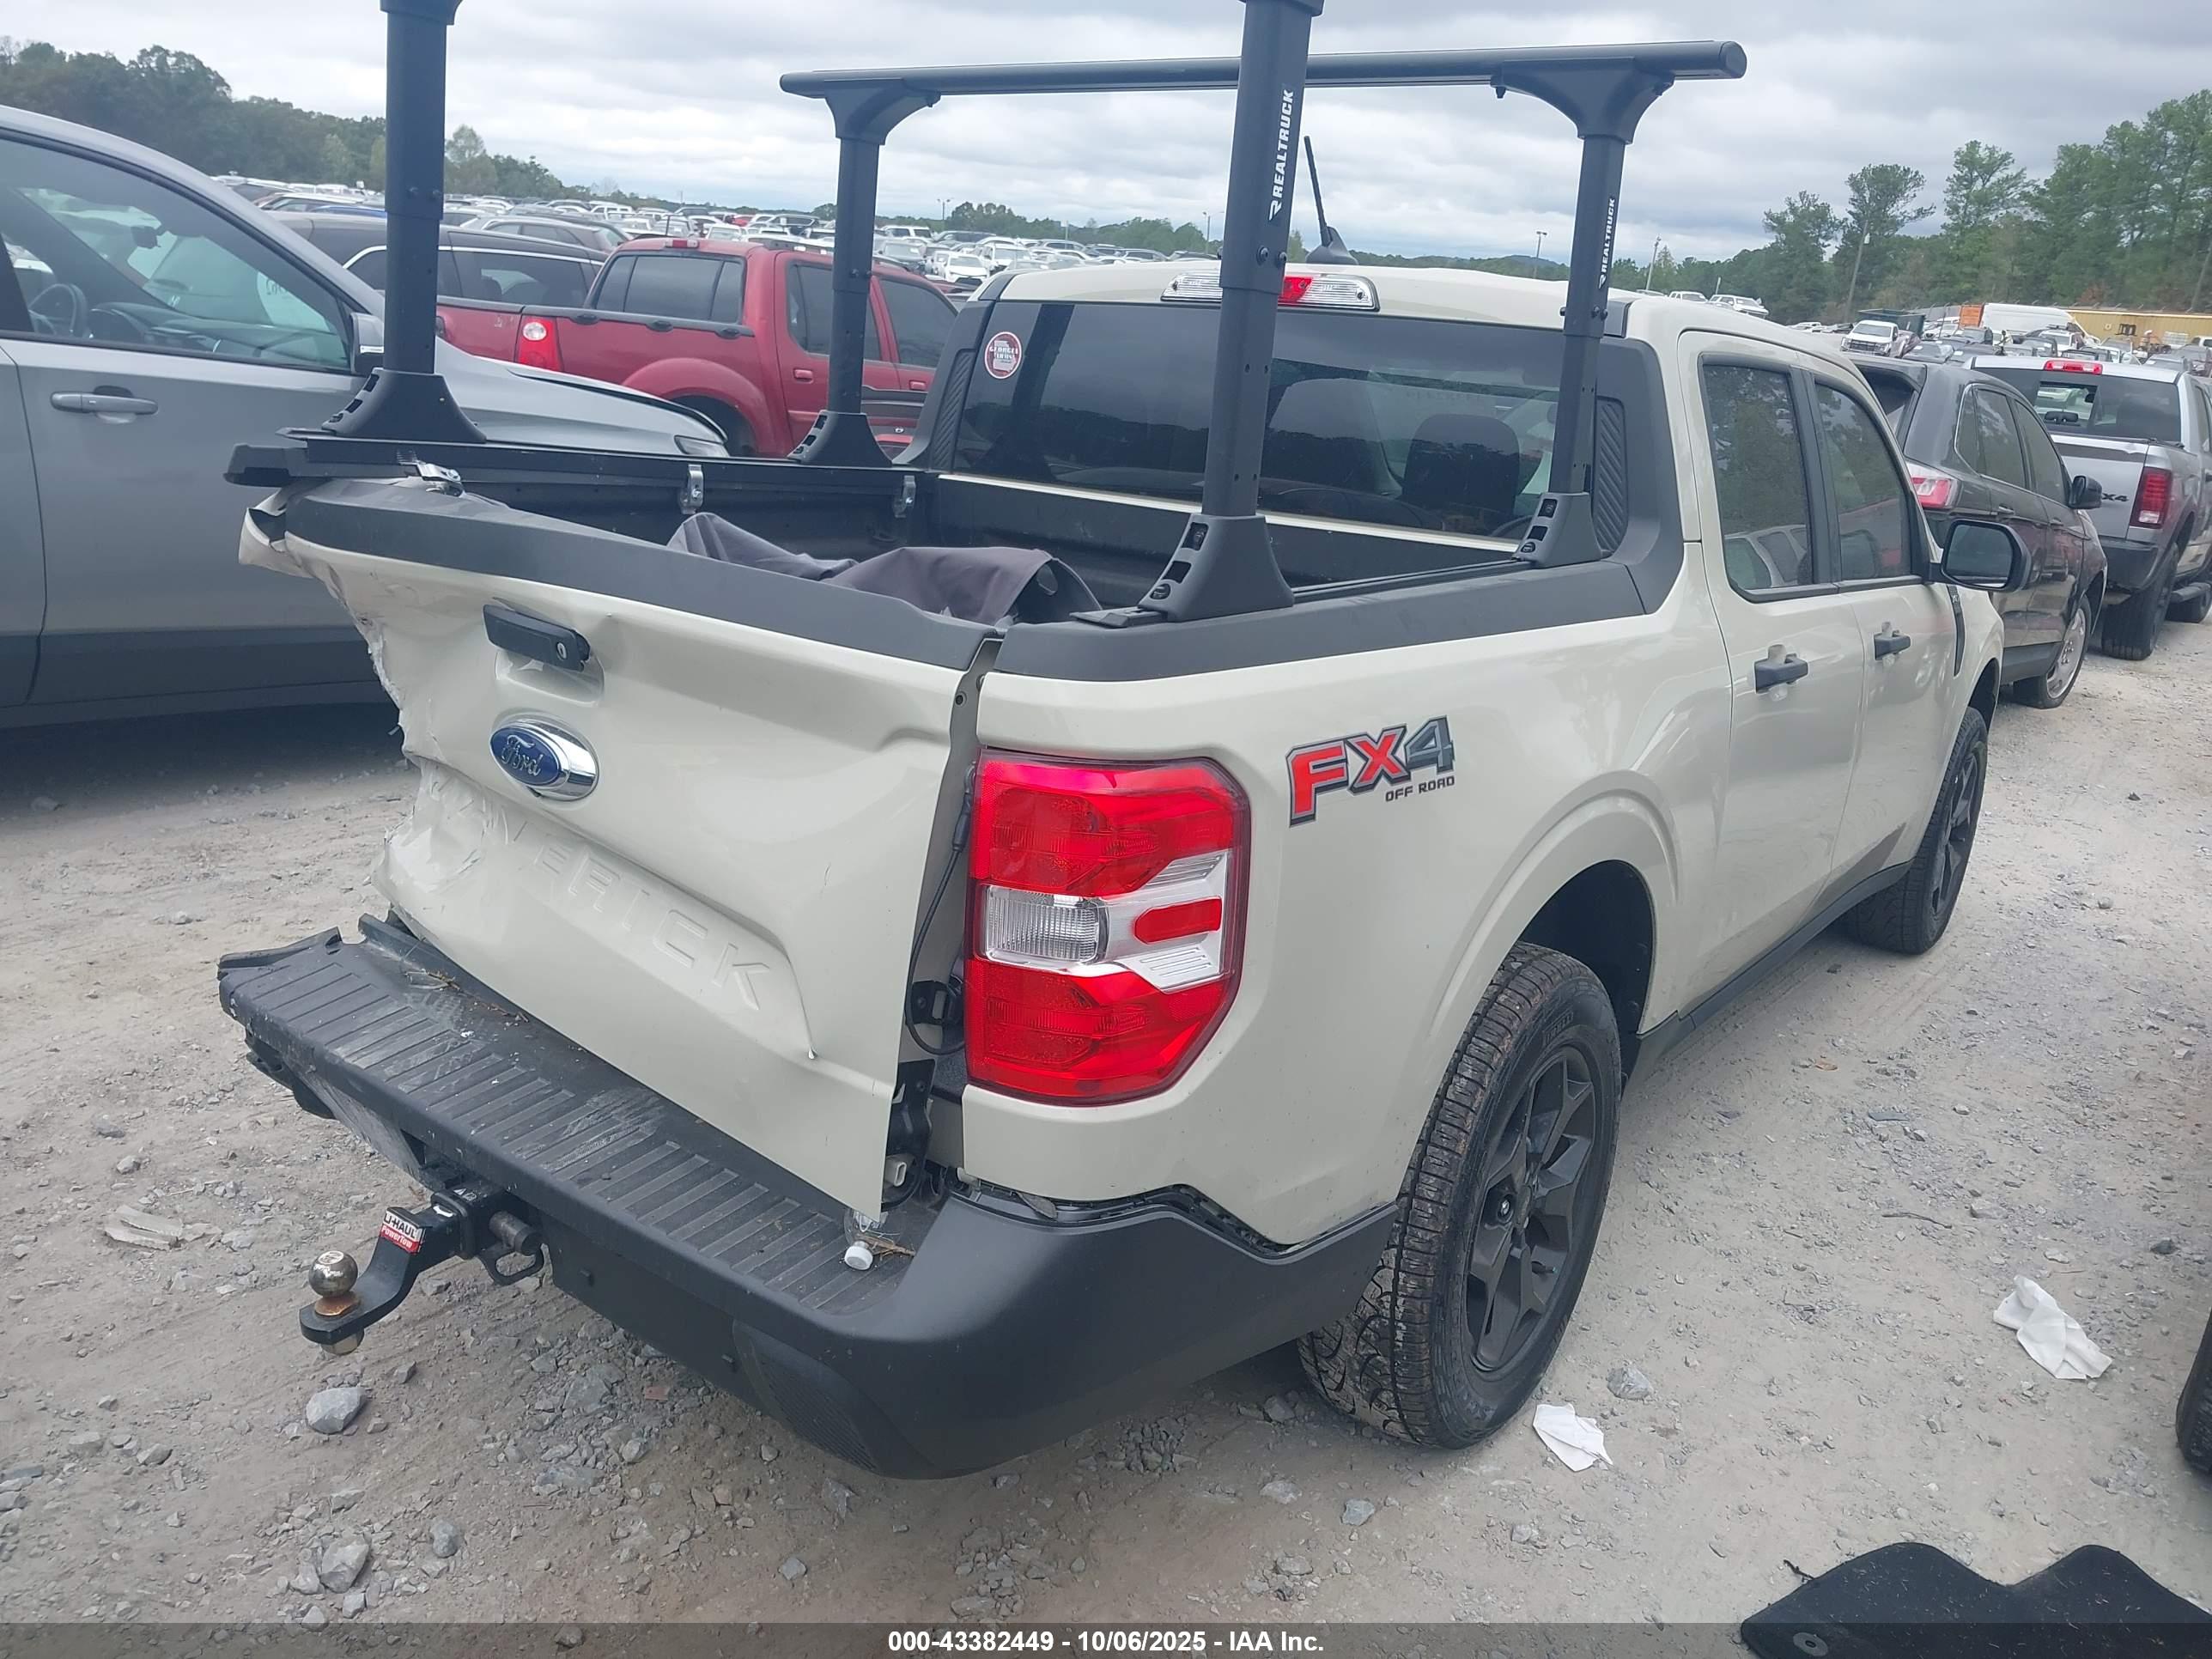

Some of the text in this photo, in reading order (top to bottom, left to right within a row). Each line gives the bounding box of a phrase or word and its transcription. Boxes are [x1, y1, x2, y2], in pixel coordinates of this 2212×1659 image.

[1272, 89, 1294, 198] REALTRUCK
[1601, 198, 1615, 273] REALTRUCK
[2101, 492, 2130, 502] X4
[501, 734, 544, 776] Ford
[1285, 714, 1456, 828] FX4
[1384, 775, 1455, 802] OFF ROAD
[434, 777, 770, 1011] VERICK
[383, 1212, 416, 1239] U-HAUL
